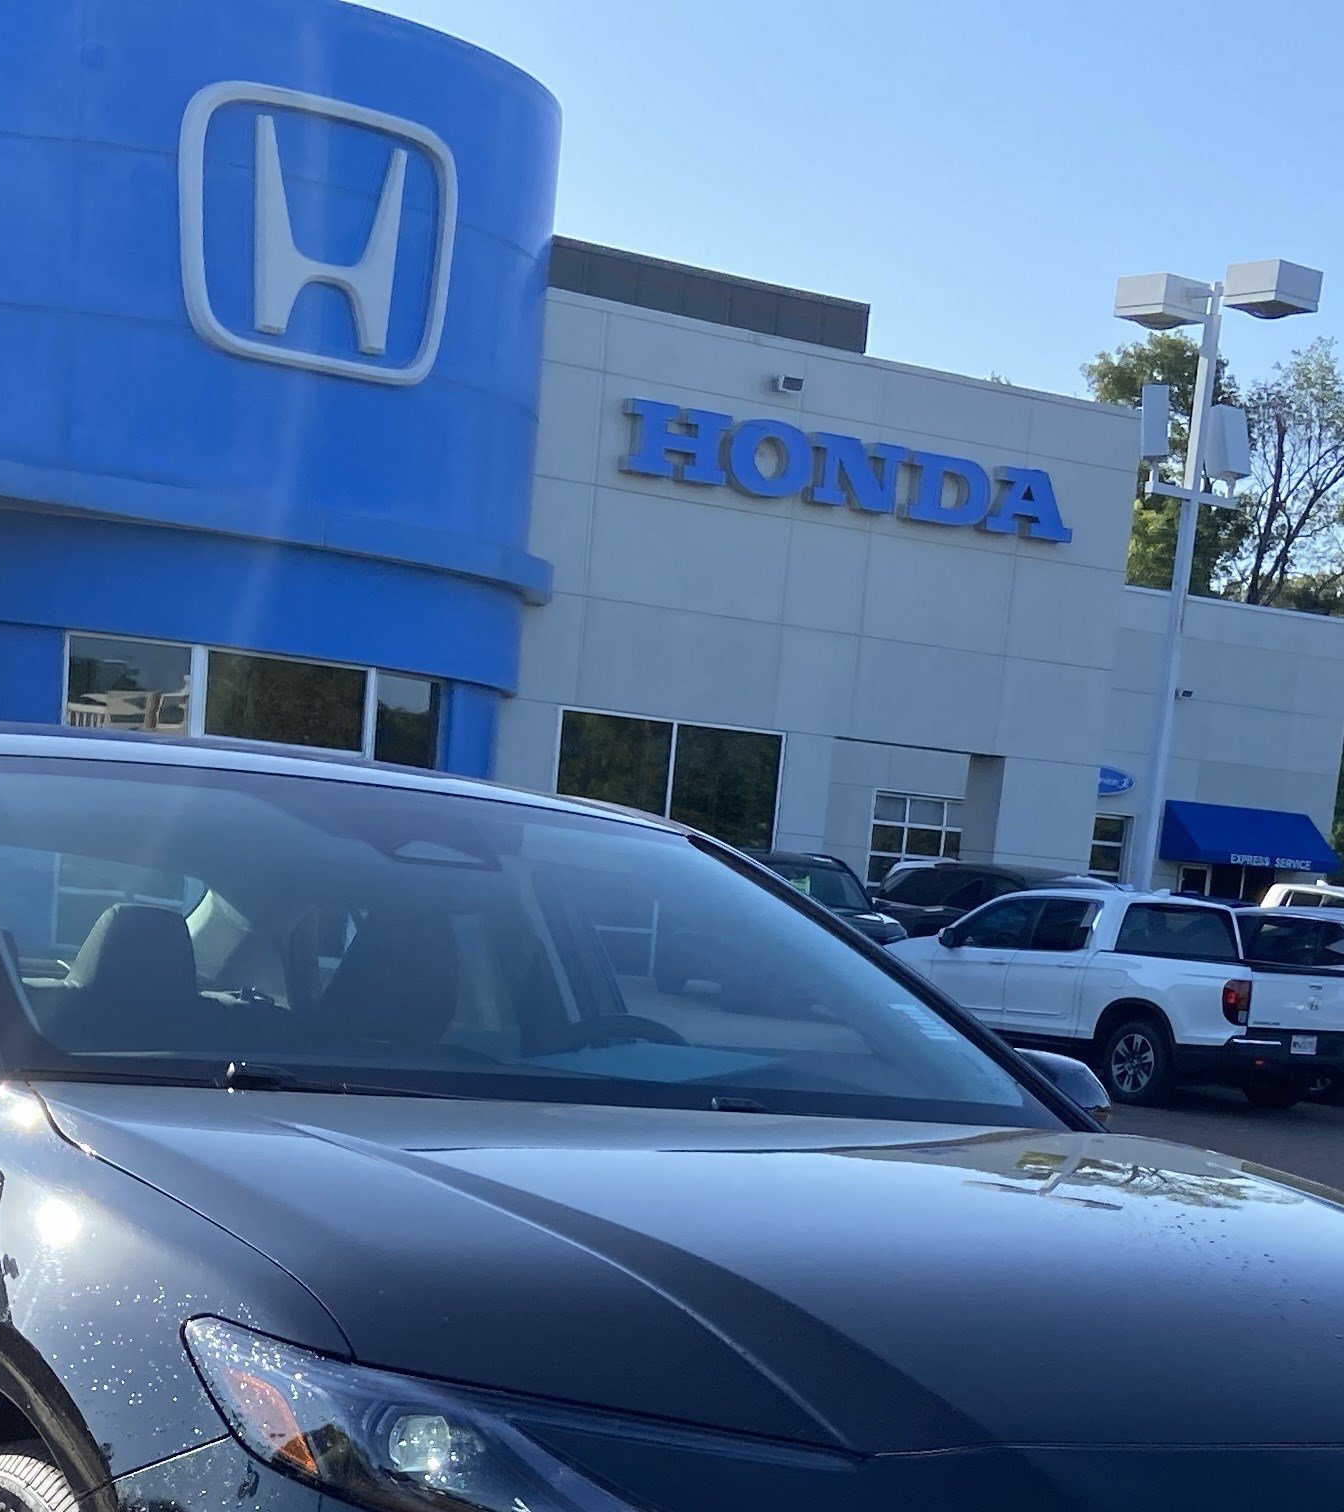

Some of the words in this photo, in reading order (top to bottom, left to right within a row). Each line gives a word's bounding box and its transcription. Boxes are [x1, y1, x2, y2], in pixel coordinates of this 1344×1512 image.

[620, 397, 1073, 544] HONDA
[1230, 853, 1270, 867] EXPRESS
[1274, 857, 1312, 871] SERVICE
